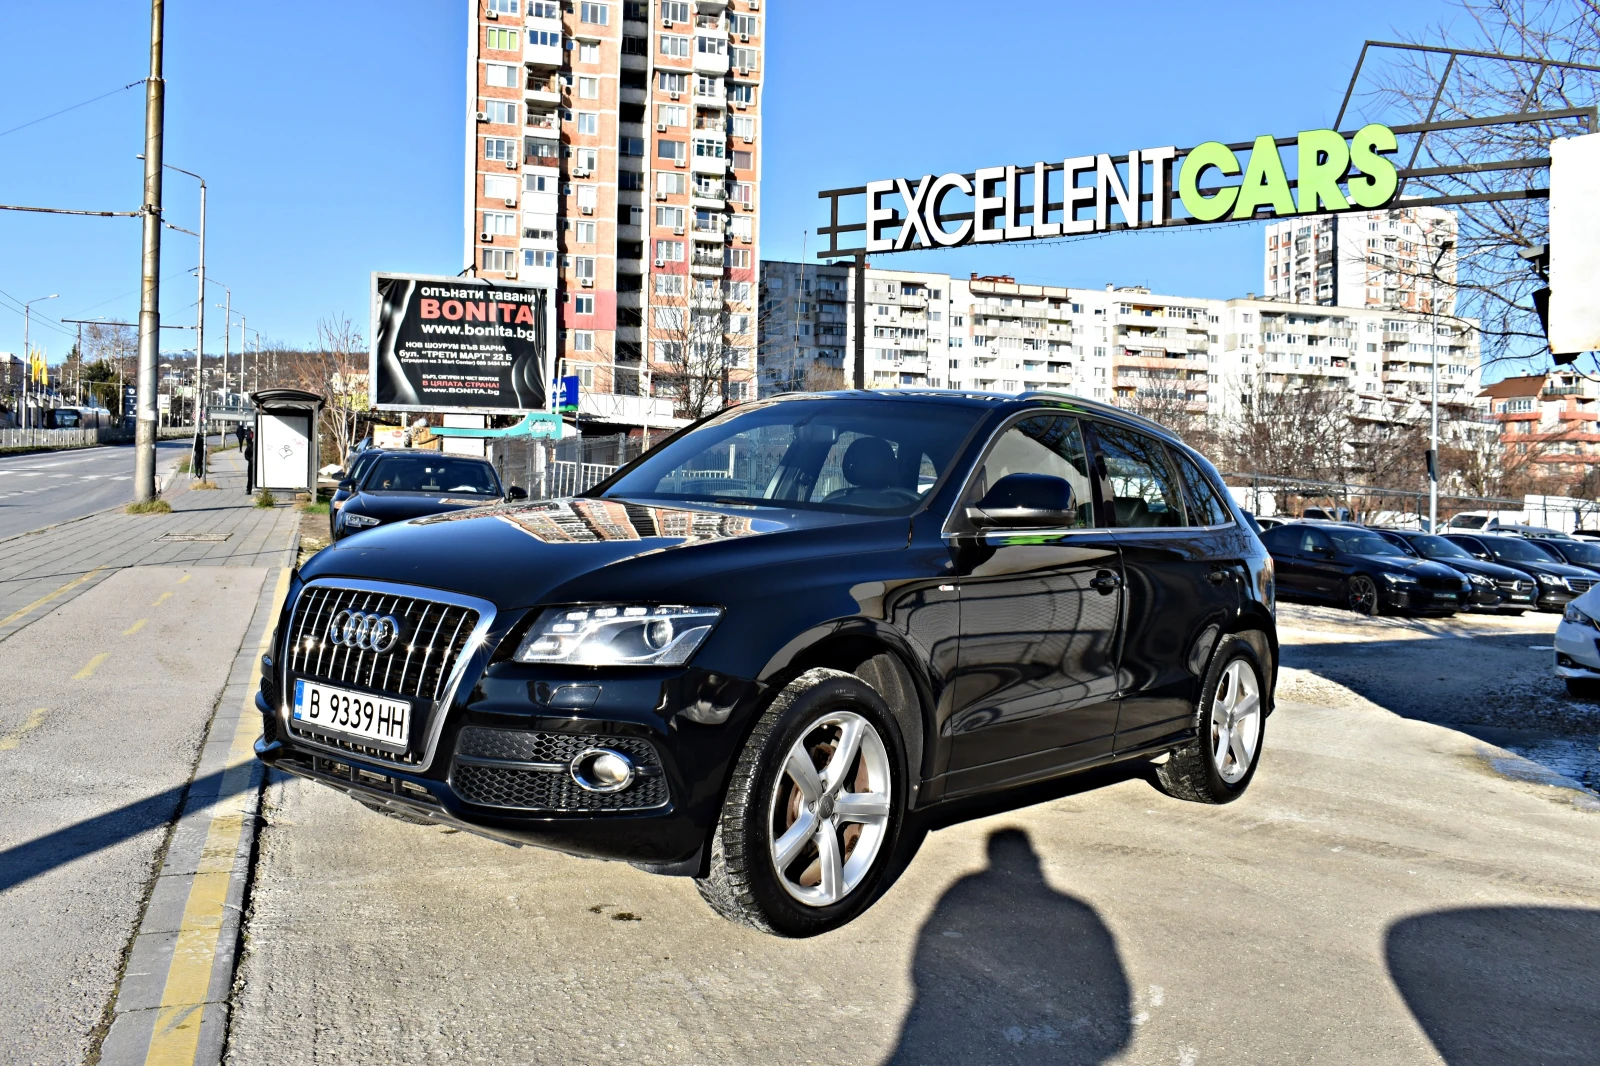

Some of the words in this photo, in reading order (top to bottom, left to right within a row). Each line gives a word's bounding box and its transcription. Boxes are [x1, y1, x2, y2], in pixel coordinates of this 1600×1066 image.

[865, 146, 1176, 252] EXCELLENT
[1178, 122, 1399, 222] CARS
[420, 287, 483, 299] опънати
[488, 291, 536, 303] тавани
[420, 299, 534, 325] BONITA
[420, 324, 535, 341] www.bonita.bg
[398, 350, 420, 358] бул.
[422, 388, 500, 396] www.BONITA.bg
[310, 689, 320, 719] B
[330, 694, 374, 732] 9339
